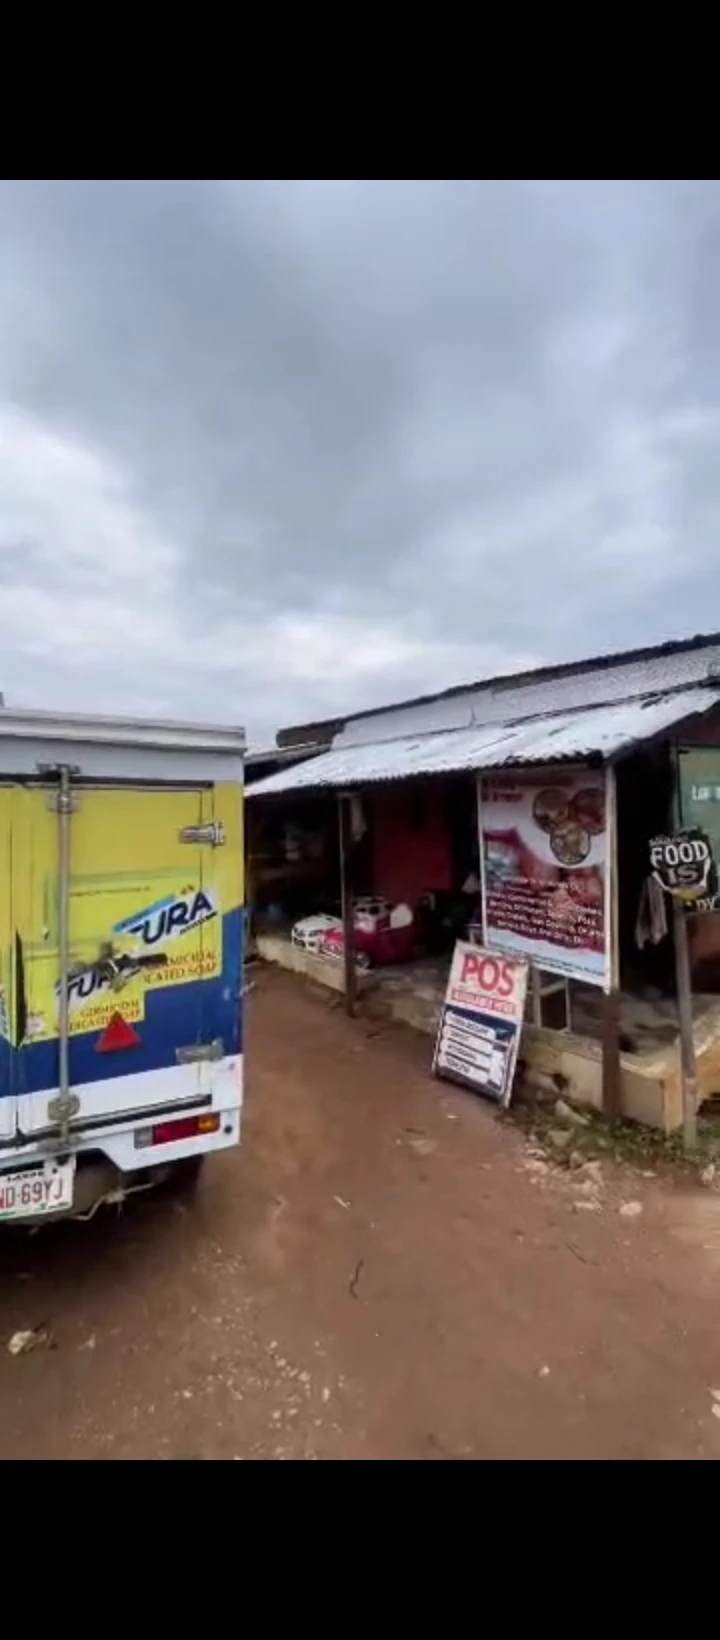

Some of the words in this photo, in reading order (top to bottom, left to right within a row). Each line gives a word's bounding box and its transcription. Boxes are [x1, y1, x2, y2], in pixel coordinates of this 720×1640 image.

[650, 840, 709, 867] FOOD
[668, 864, 699, 885] IS
[460, 953, 514, 996] POS
